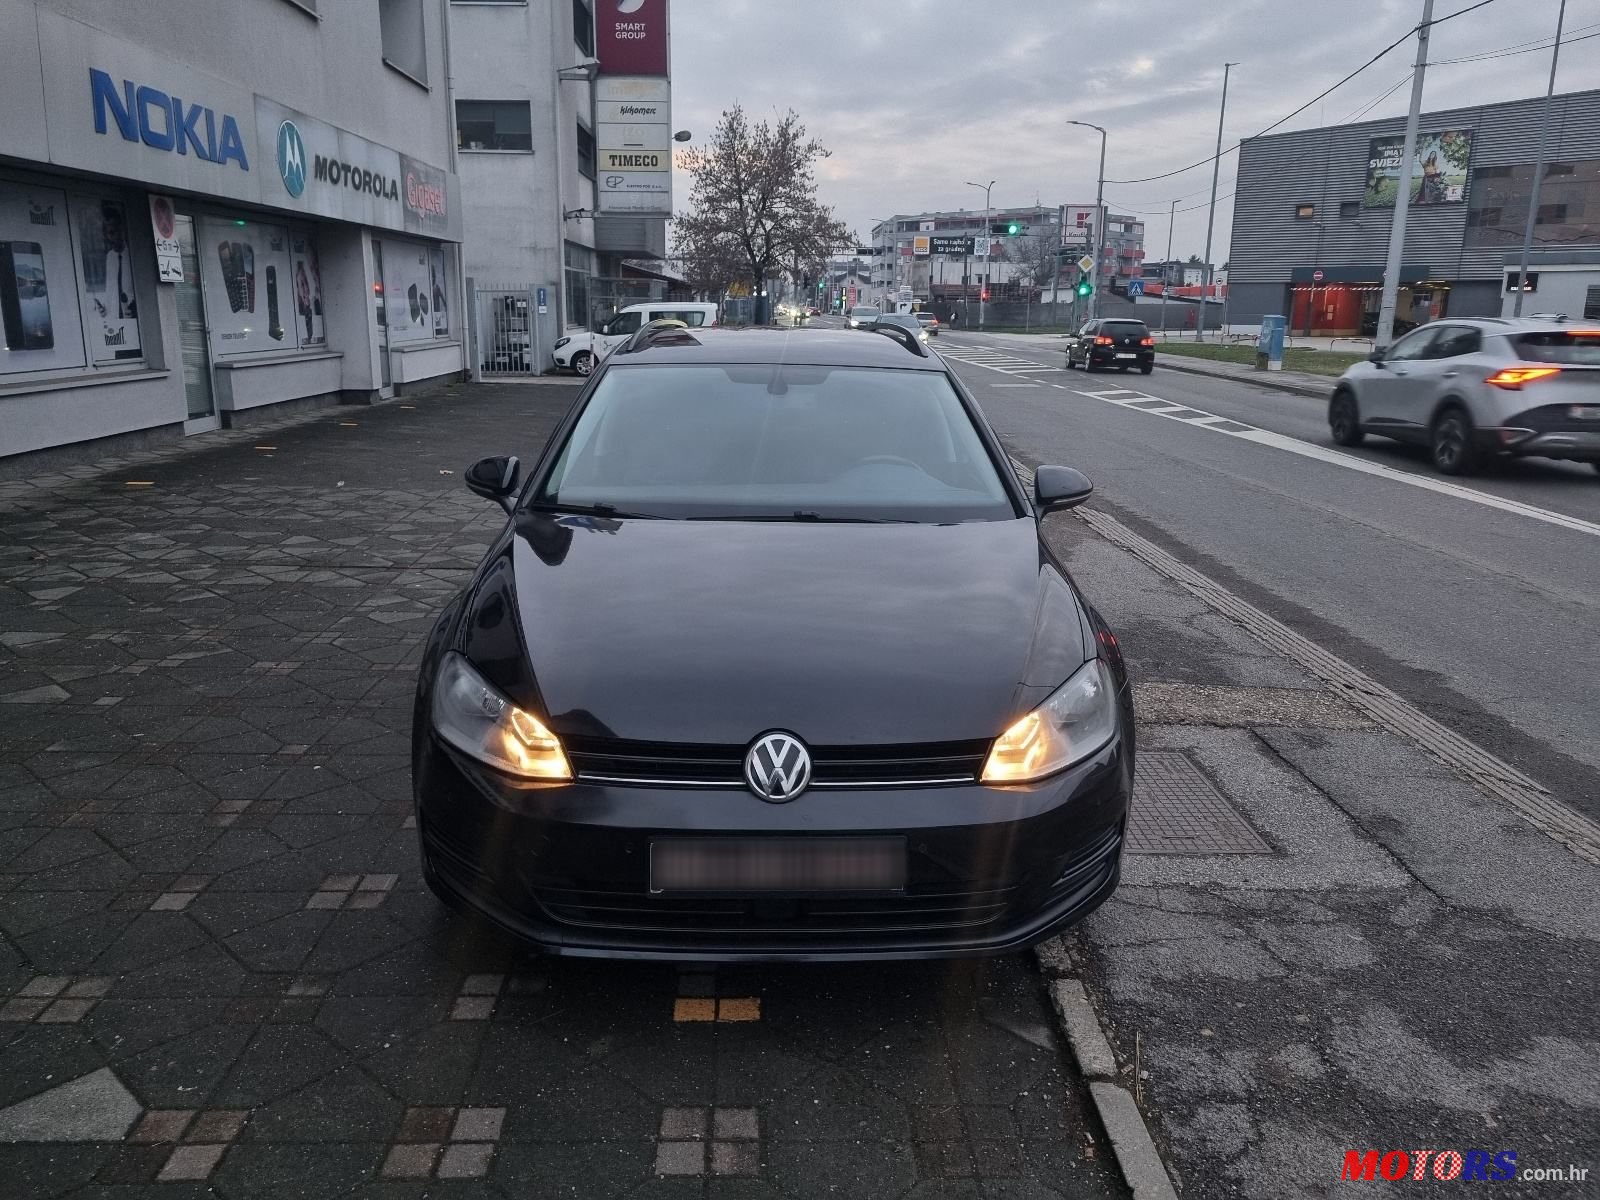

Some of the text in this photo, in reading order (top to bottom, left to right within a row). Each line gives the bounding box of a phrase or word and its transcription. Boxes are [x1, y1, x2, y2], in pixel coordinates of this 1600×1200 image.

[615, 22, 646, 31] SMART
[615, 31, 646, 39] GROUP
[89, 67, 249, 171] NOKIA
[609, 155, 658, 167] TIMECO
[314, 153, 399, 202] MOTOROLA
